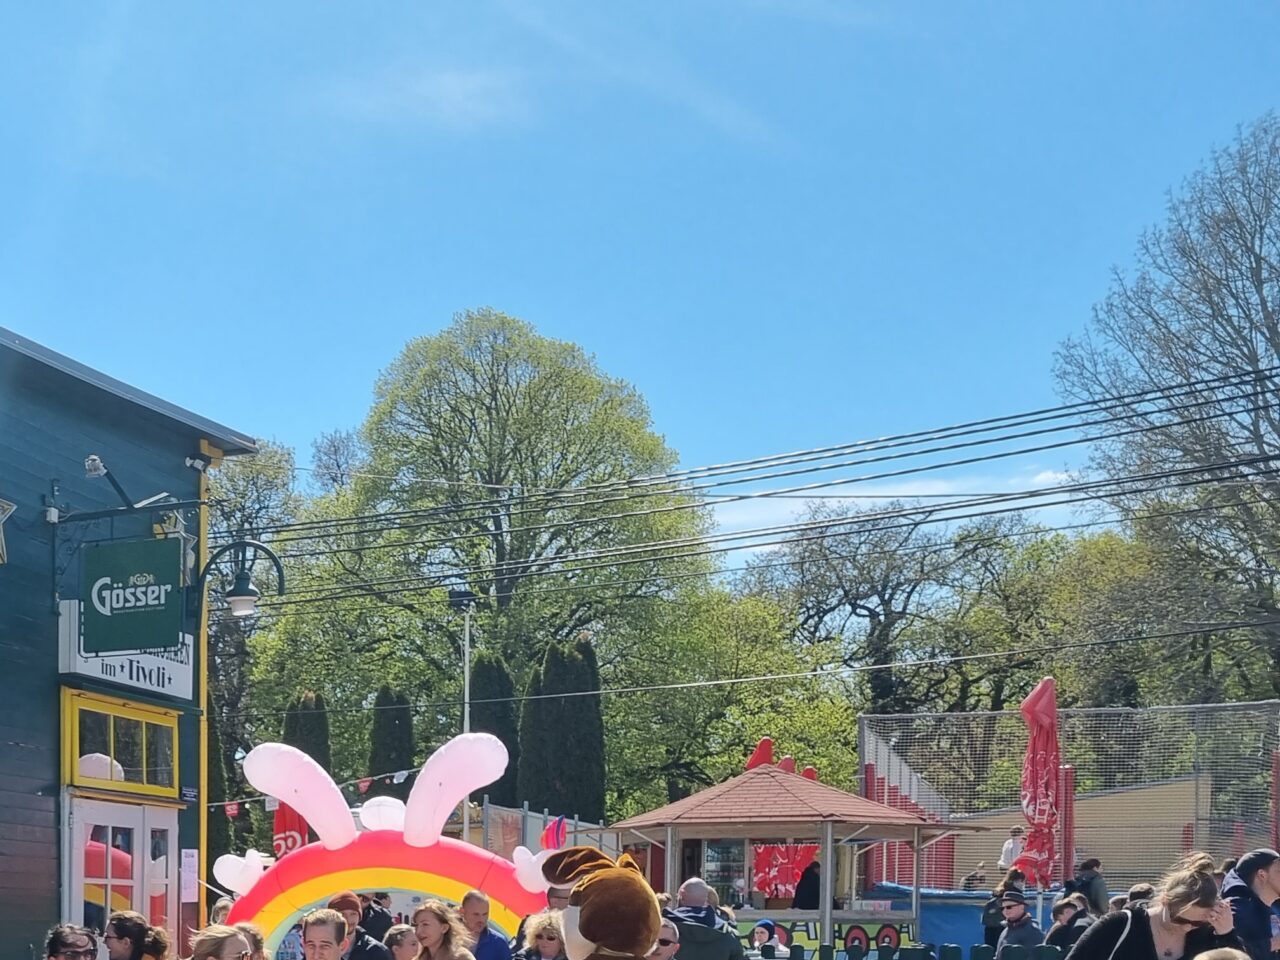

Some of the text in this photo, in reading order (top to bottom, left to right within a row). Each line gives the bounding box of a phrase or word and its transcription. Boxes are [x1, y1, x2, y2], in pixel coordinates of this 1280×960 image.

[91, 577, 172, 616] Gösser
[101, 658, 166, 688] im Tivoli
